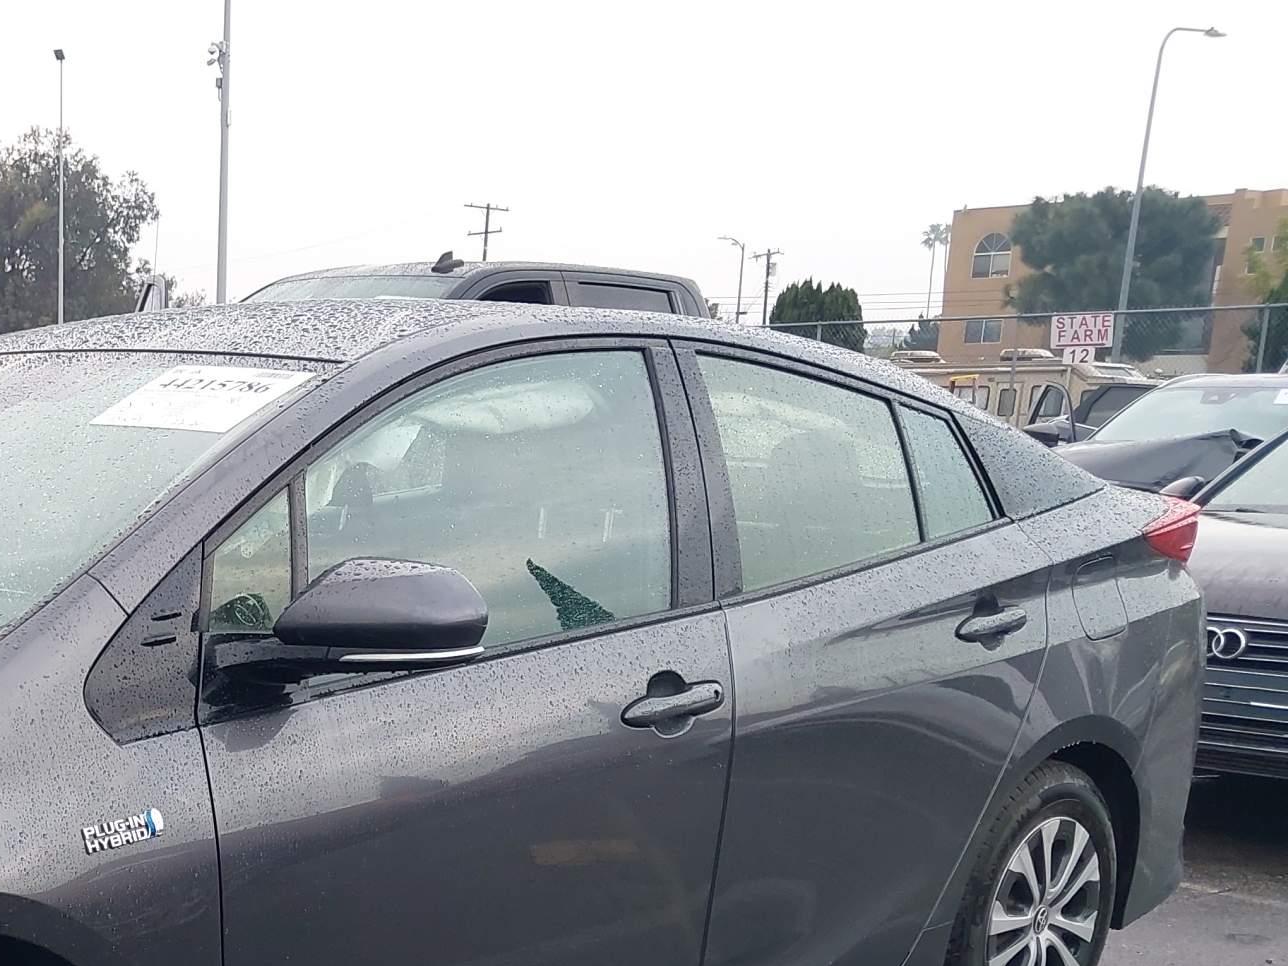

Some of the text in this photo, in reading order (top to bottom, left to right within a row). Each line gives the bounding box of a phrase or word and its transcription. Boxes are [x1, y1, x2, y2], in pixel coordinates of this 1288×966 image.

[1056, 315, 1112, 329] STATE
[1057, 329, 1109, 343] FARM
[1069, 348, 1089, 364] 12
[159, 378, 273, 393] 44215786
[82, 813, 146, 840] PLUG-IN
[85, 827, 149, 854] HYBRID
